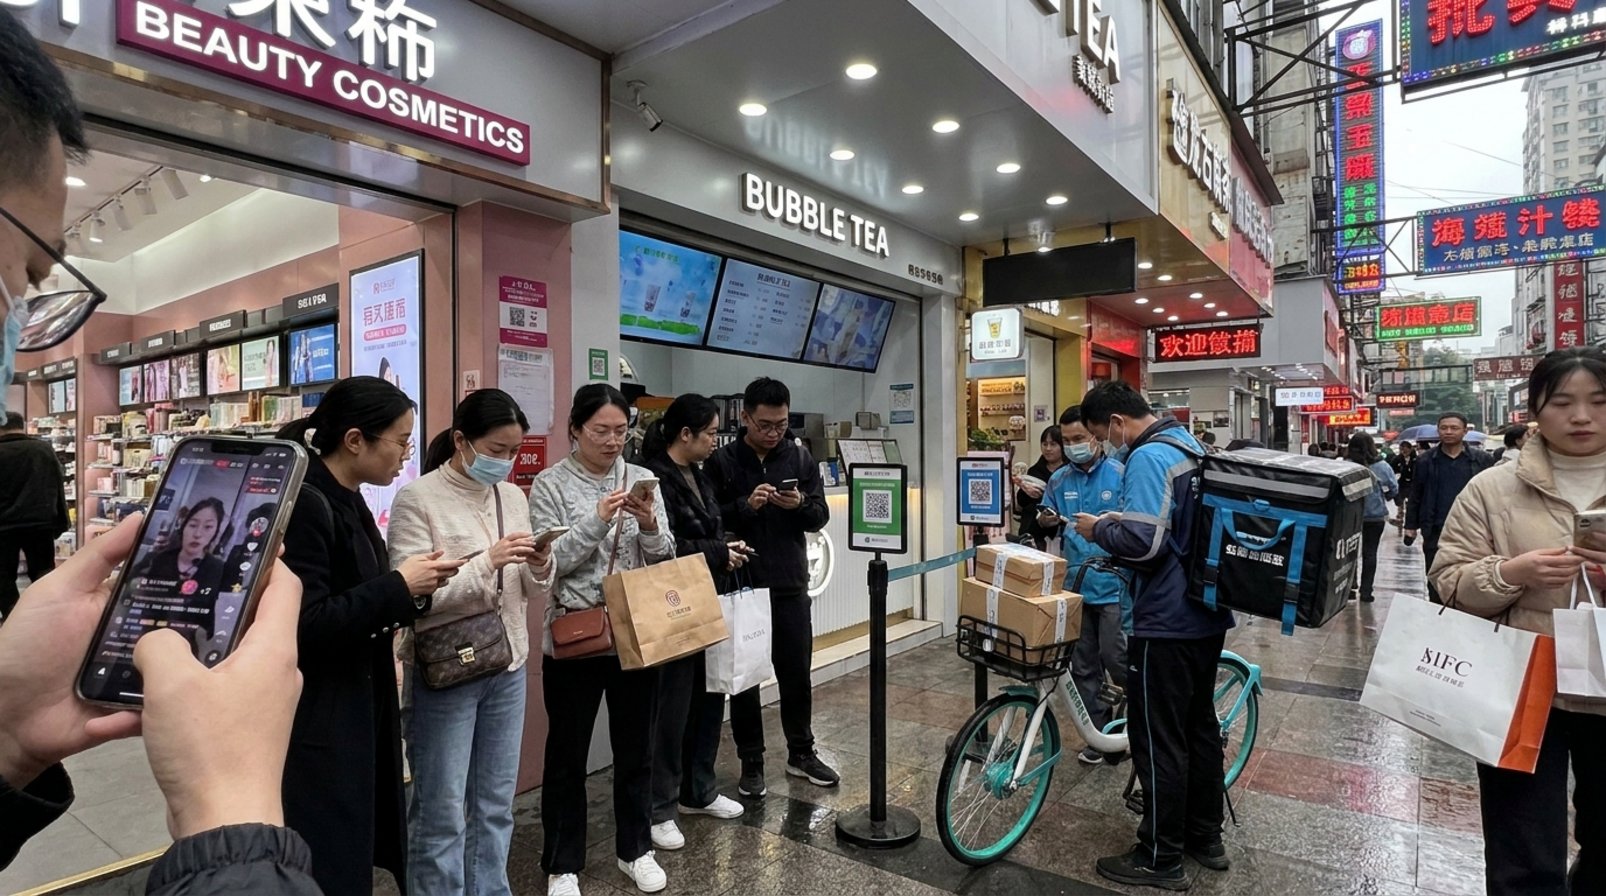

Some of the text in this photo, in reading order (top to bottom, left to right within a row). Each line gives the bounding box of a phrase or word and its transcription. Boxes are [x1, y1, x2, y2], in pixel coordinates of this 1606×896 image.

[136, 1, 525, 154] BEAUTY COSMETICS
[746, 172, 890, 257] BUBBLE TEA
